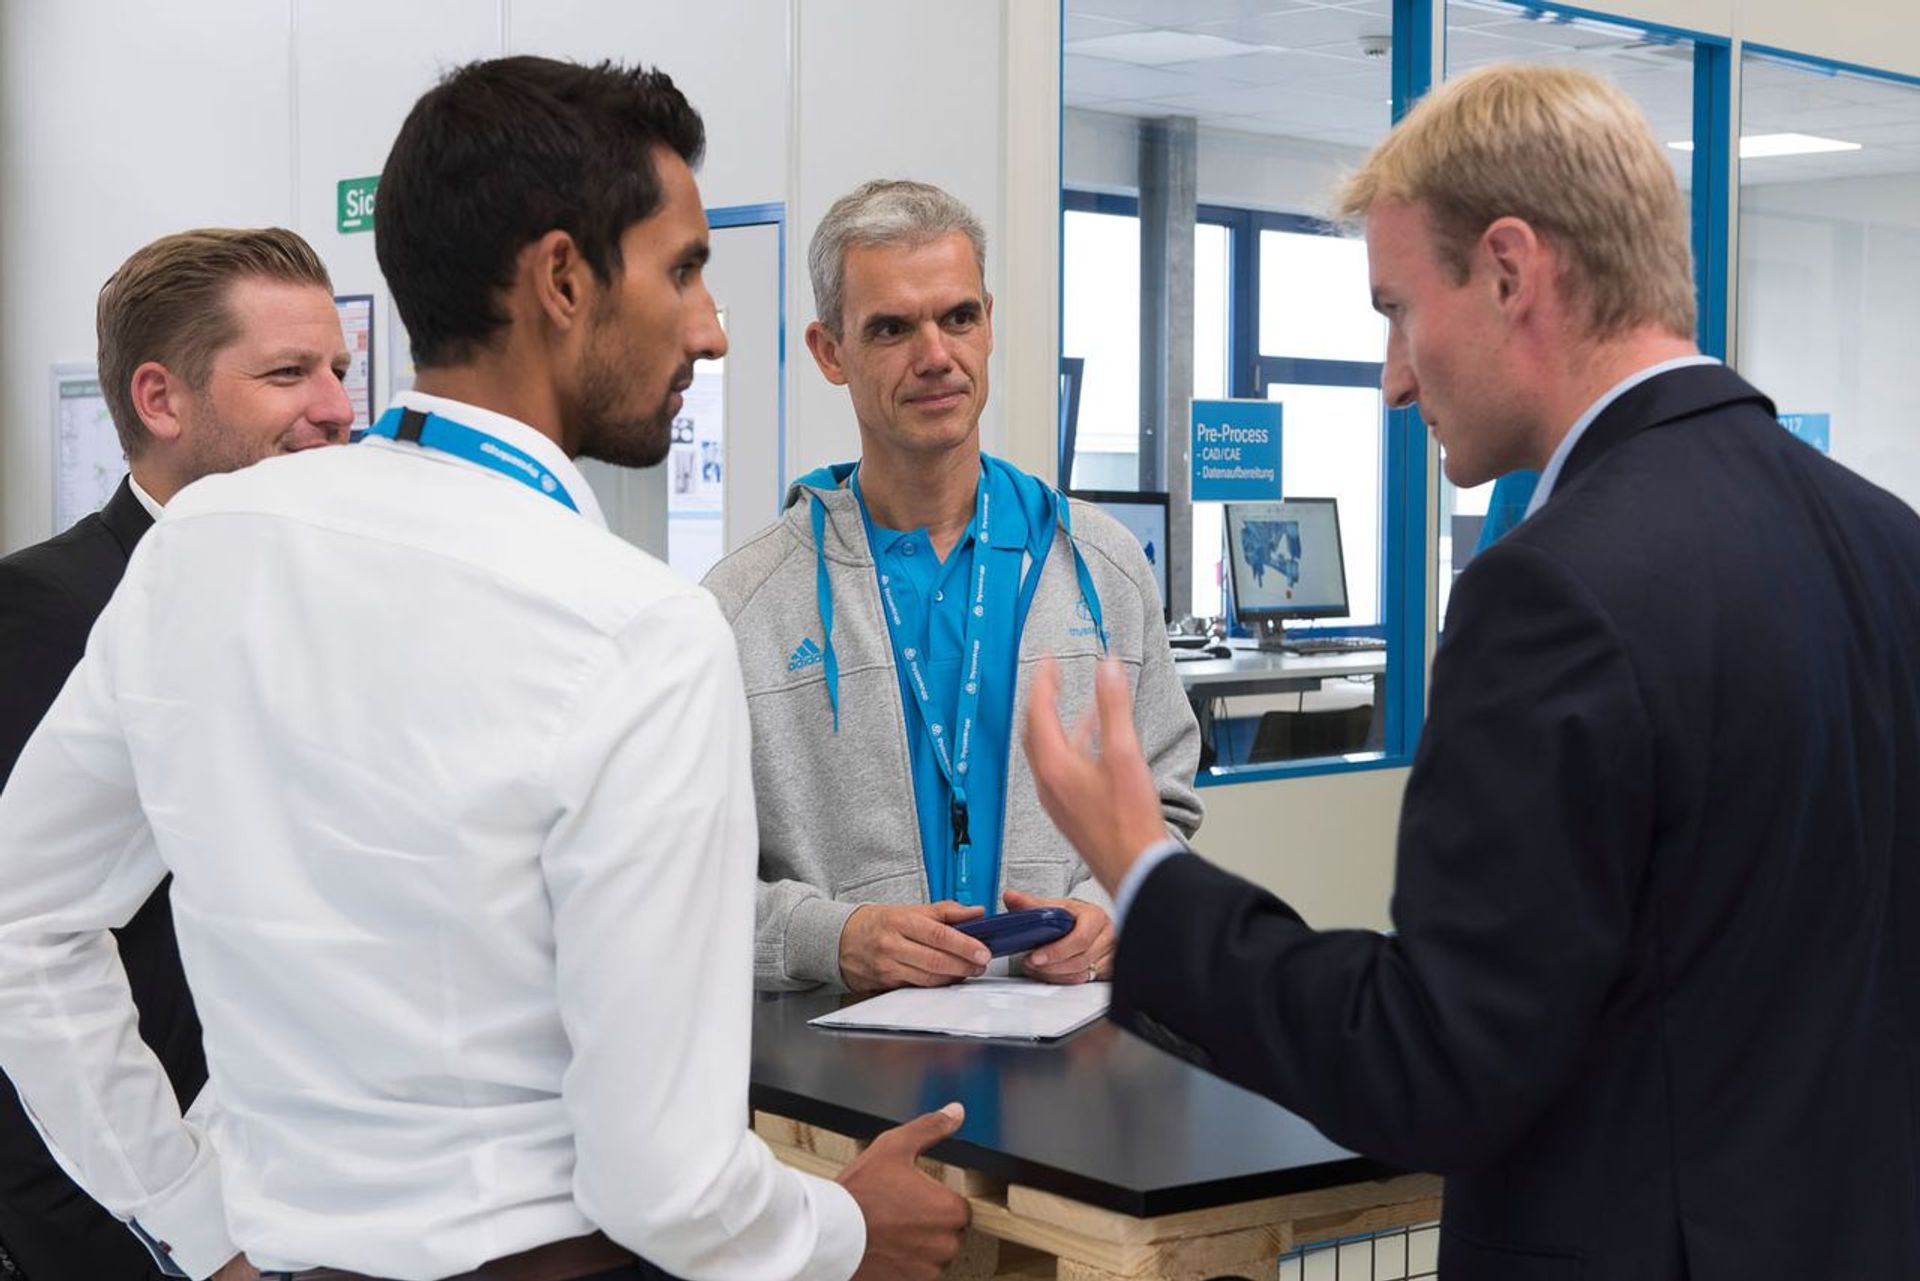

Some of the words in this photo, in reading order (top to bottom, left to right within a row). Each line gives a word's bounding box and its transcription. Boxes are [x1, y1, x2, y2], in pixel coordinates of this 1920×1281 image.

[347, 188, 377, 217] Sic
[1197, 423, 1269, 443] Pre-Process
[1202, 447, 1241, 461] CAD/CAE
